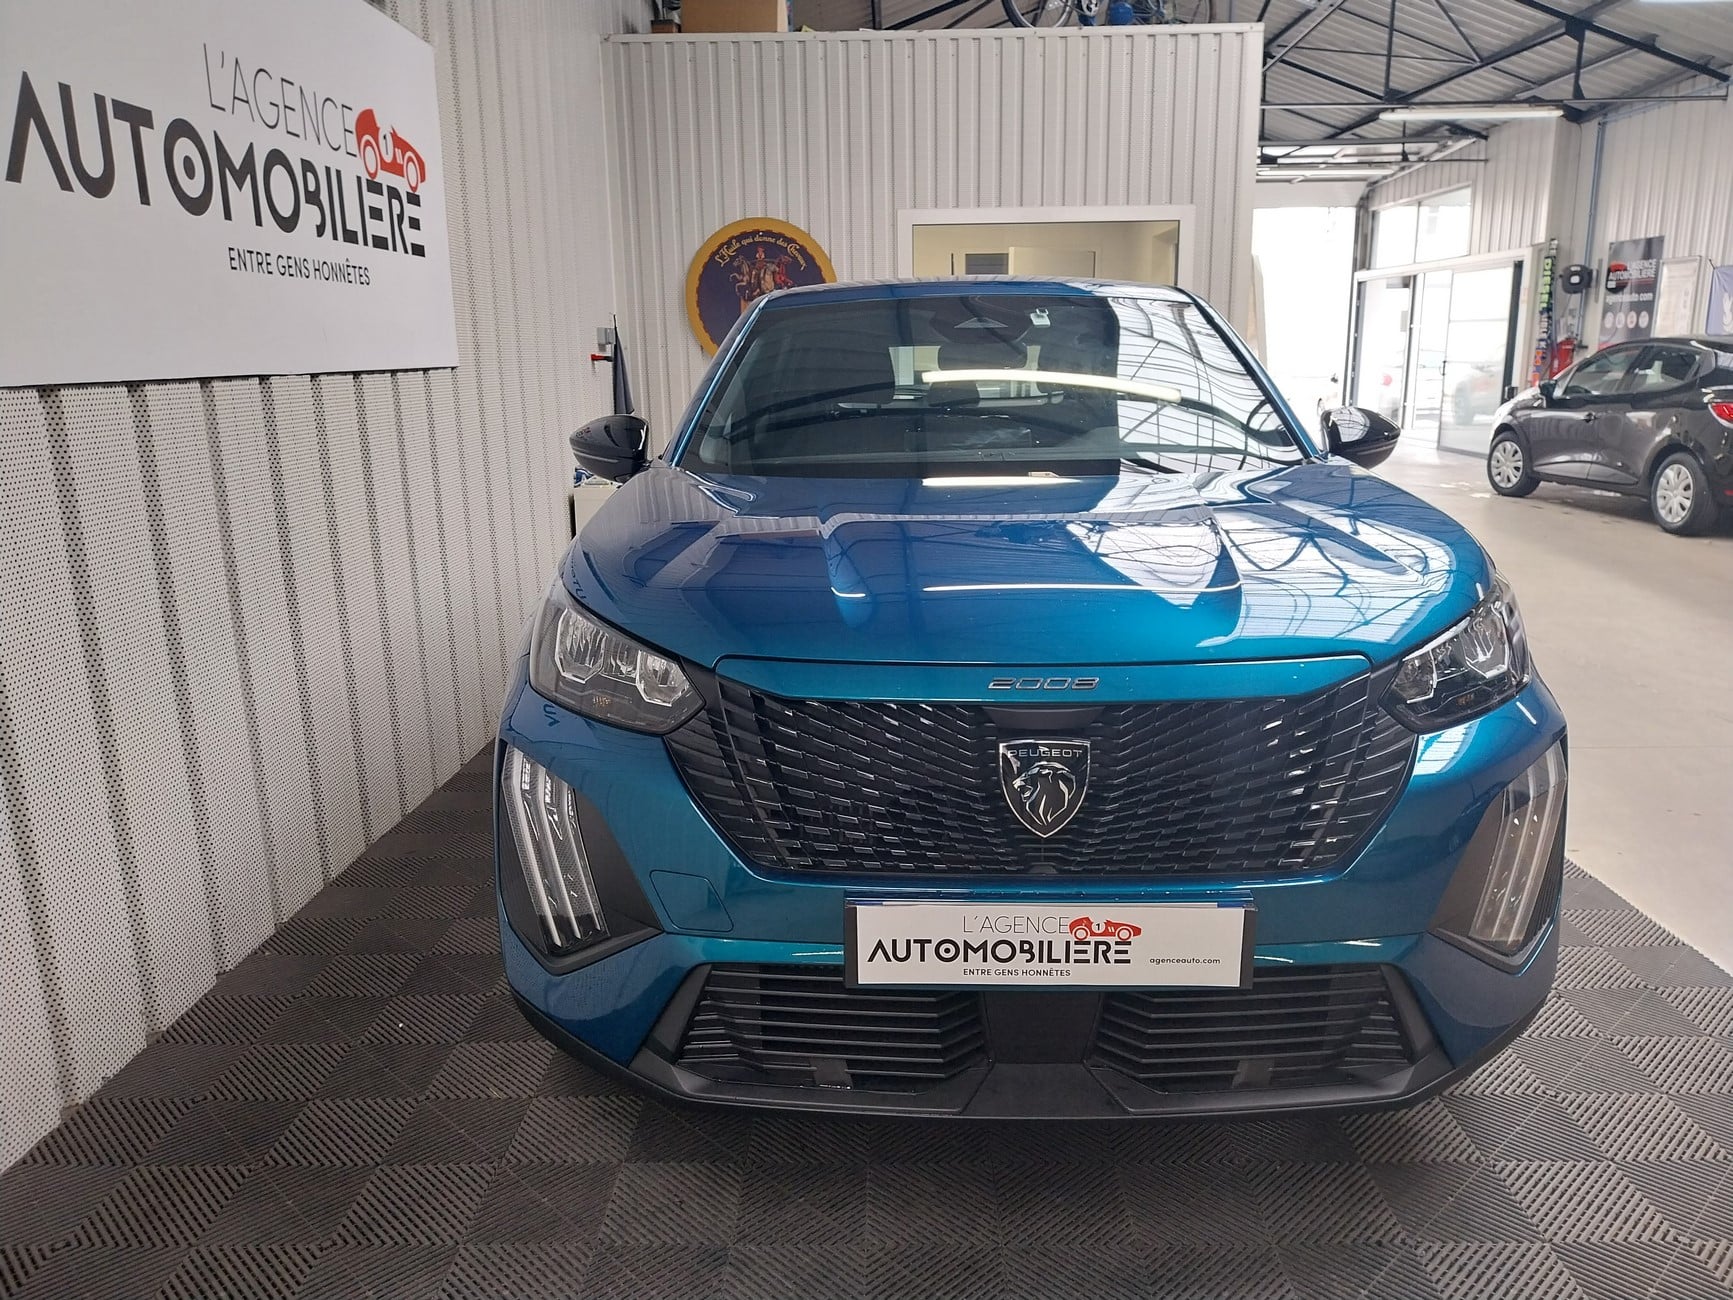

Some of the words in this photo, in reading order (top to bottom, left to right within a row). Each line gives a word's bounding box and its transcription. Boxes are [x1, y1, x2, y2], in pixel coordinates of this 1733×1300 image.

[203, 43, 358, 157] L'AGENCE
[741, 236, 753, 246] qui
[754, 235, 776, 243] donne
[777, 239, 788, 248] des
[228, 247, 274, 275] ENTRE
[276, 254, 311, 279] GENS
[313, 257, 371, 286] HONNÊTES
[987, 677, 1100, 691] 2008
[1007, 749, 1083, 758] PEUGEOT
[963, 915, 1070, 934] L'AGENCE
[1149, 956, 1221, 968] agenceauto.com
[963, 968, 992, 976] ENTRE
[994, 968, 1019, 977] GENS
[1021, 967, 1071, 977] HONNÊTES
